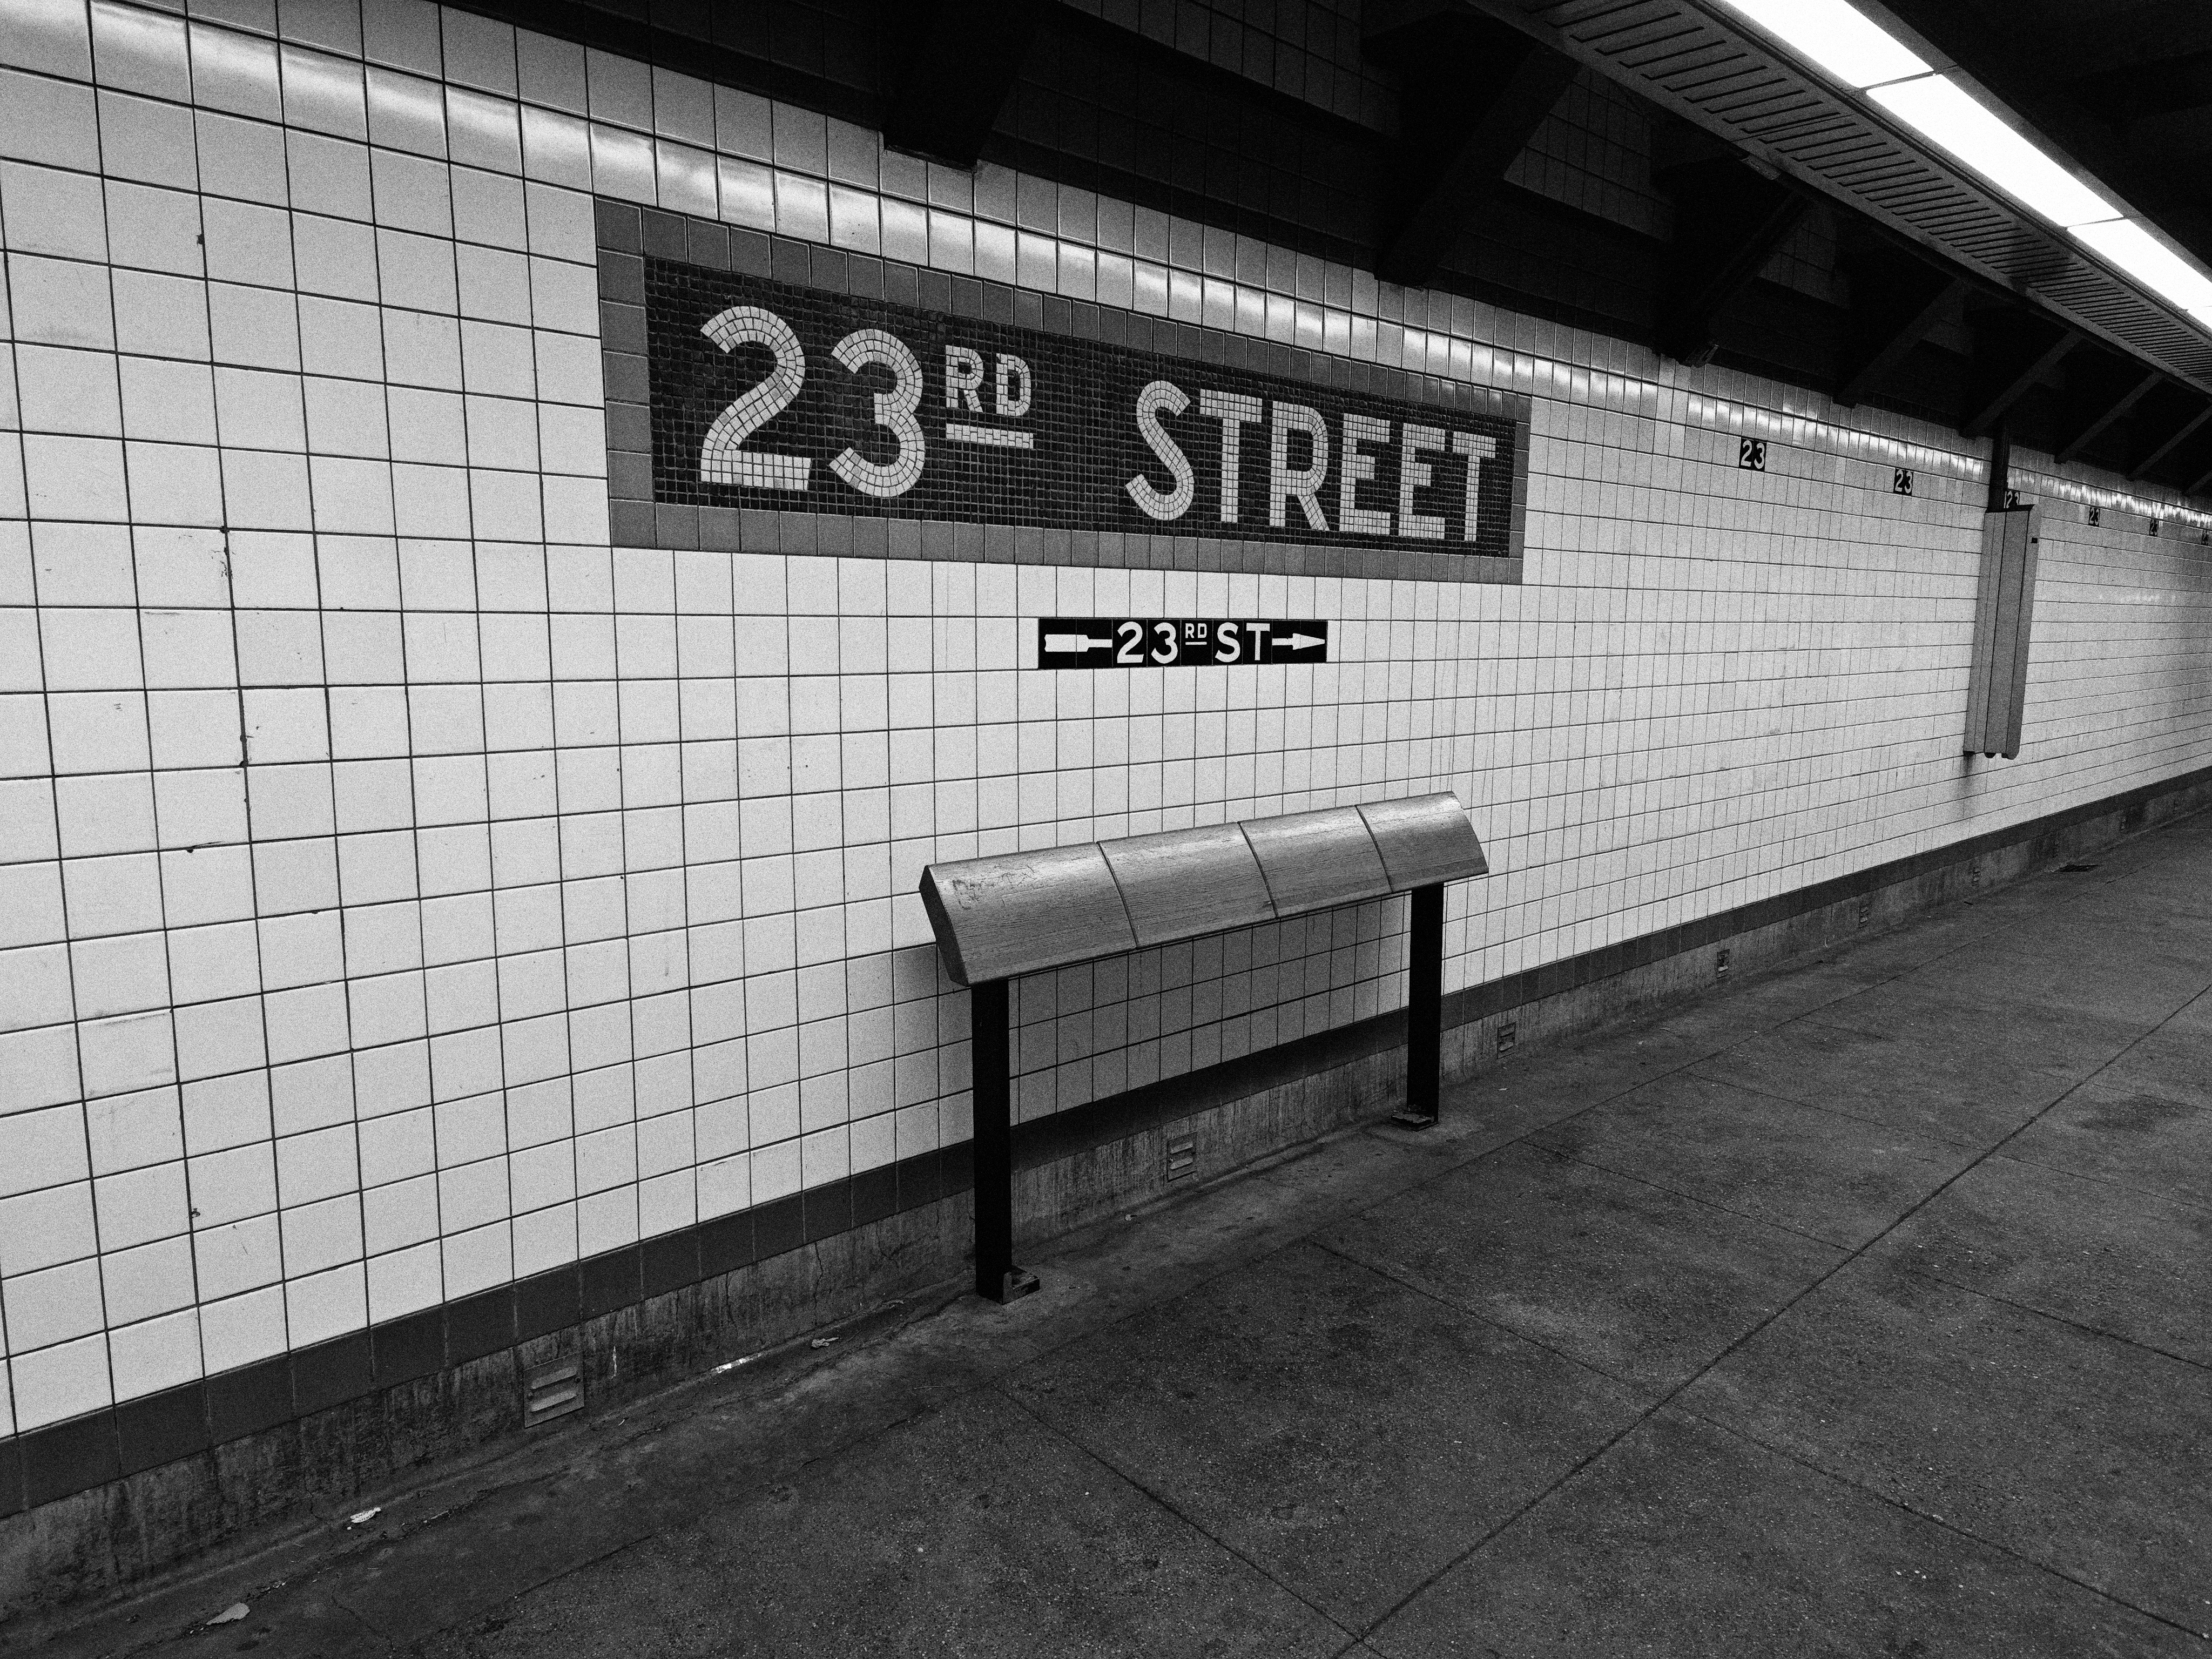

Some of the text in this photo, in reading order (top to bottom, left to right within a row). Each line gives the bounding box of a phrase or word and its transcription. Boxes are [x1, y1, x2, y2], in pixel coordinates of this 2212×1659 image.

[700, 305, 1497, 542] 23RD STREET
[1740, 439, 1766, 469] 23
[1894, 469, 1913, 494] 23
[2089, 507, 2100, 526] 23
[1116, 621, 1271, 664] 23RD ST
